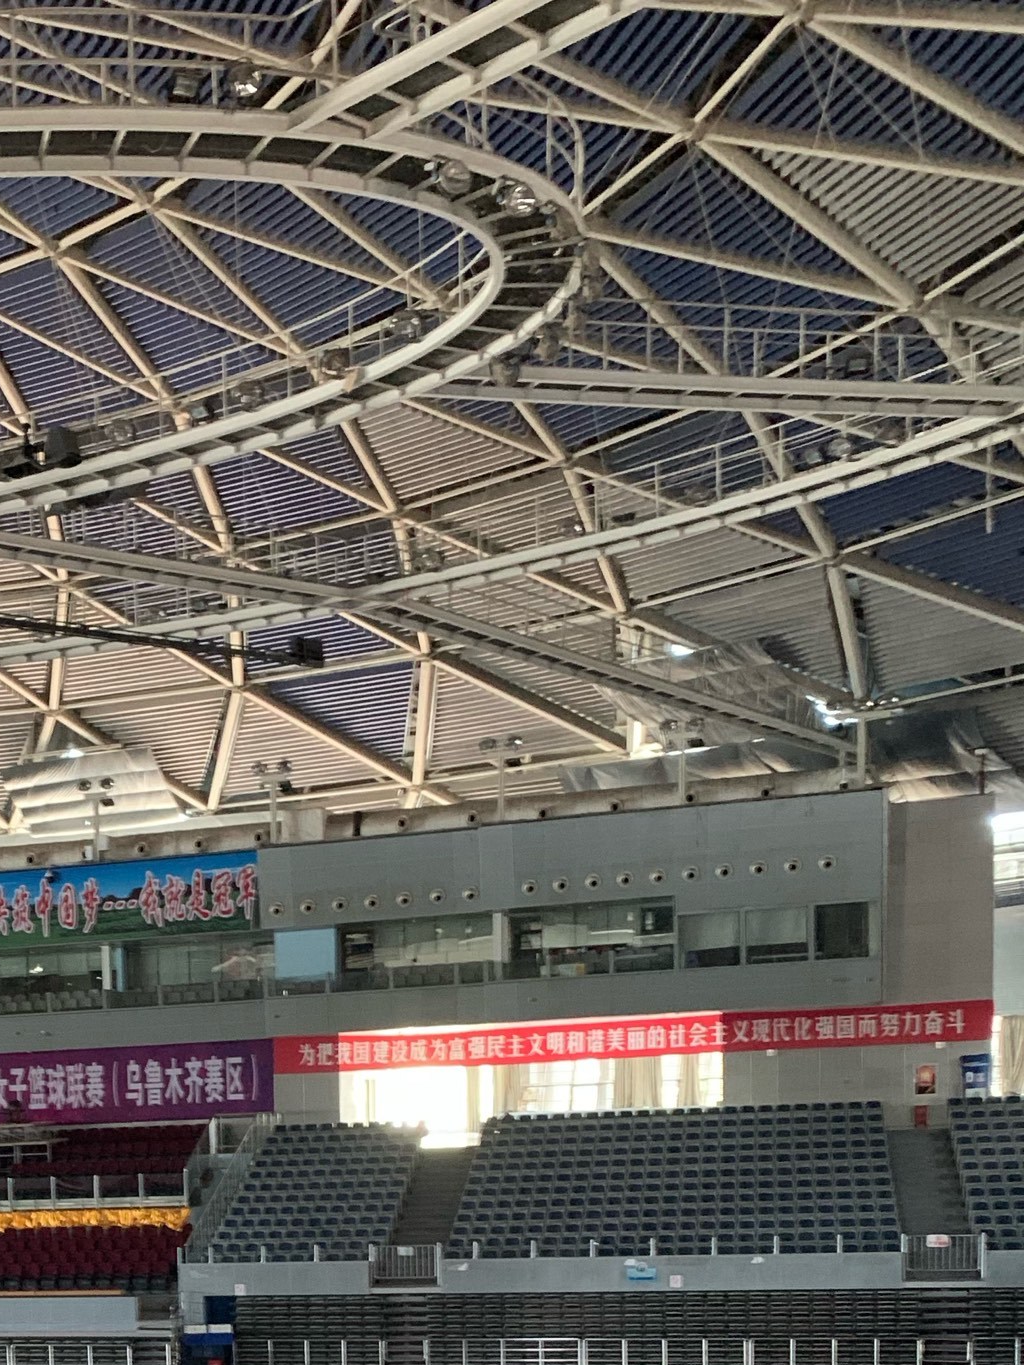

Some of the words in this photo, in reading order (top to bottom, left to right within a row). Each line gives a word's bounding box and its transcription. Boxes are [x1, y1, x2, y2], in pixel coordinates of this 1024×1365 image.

[298, 1009, 966, 1067] 为把我国建设成为富强民主文明和谐美丽的社会主义现代化强国而努力奋斗
